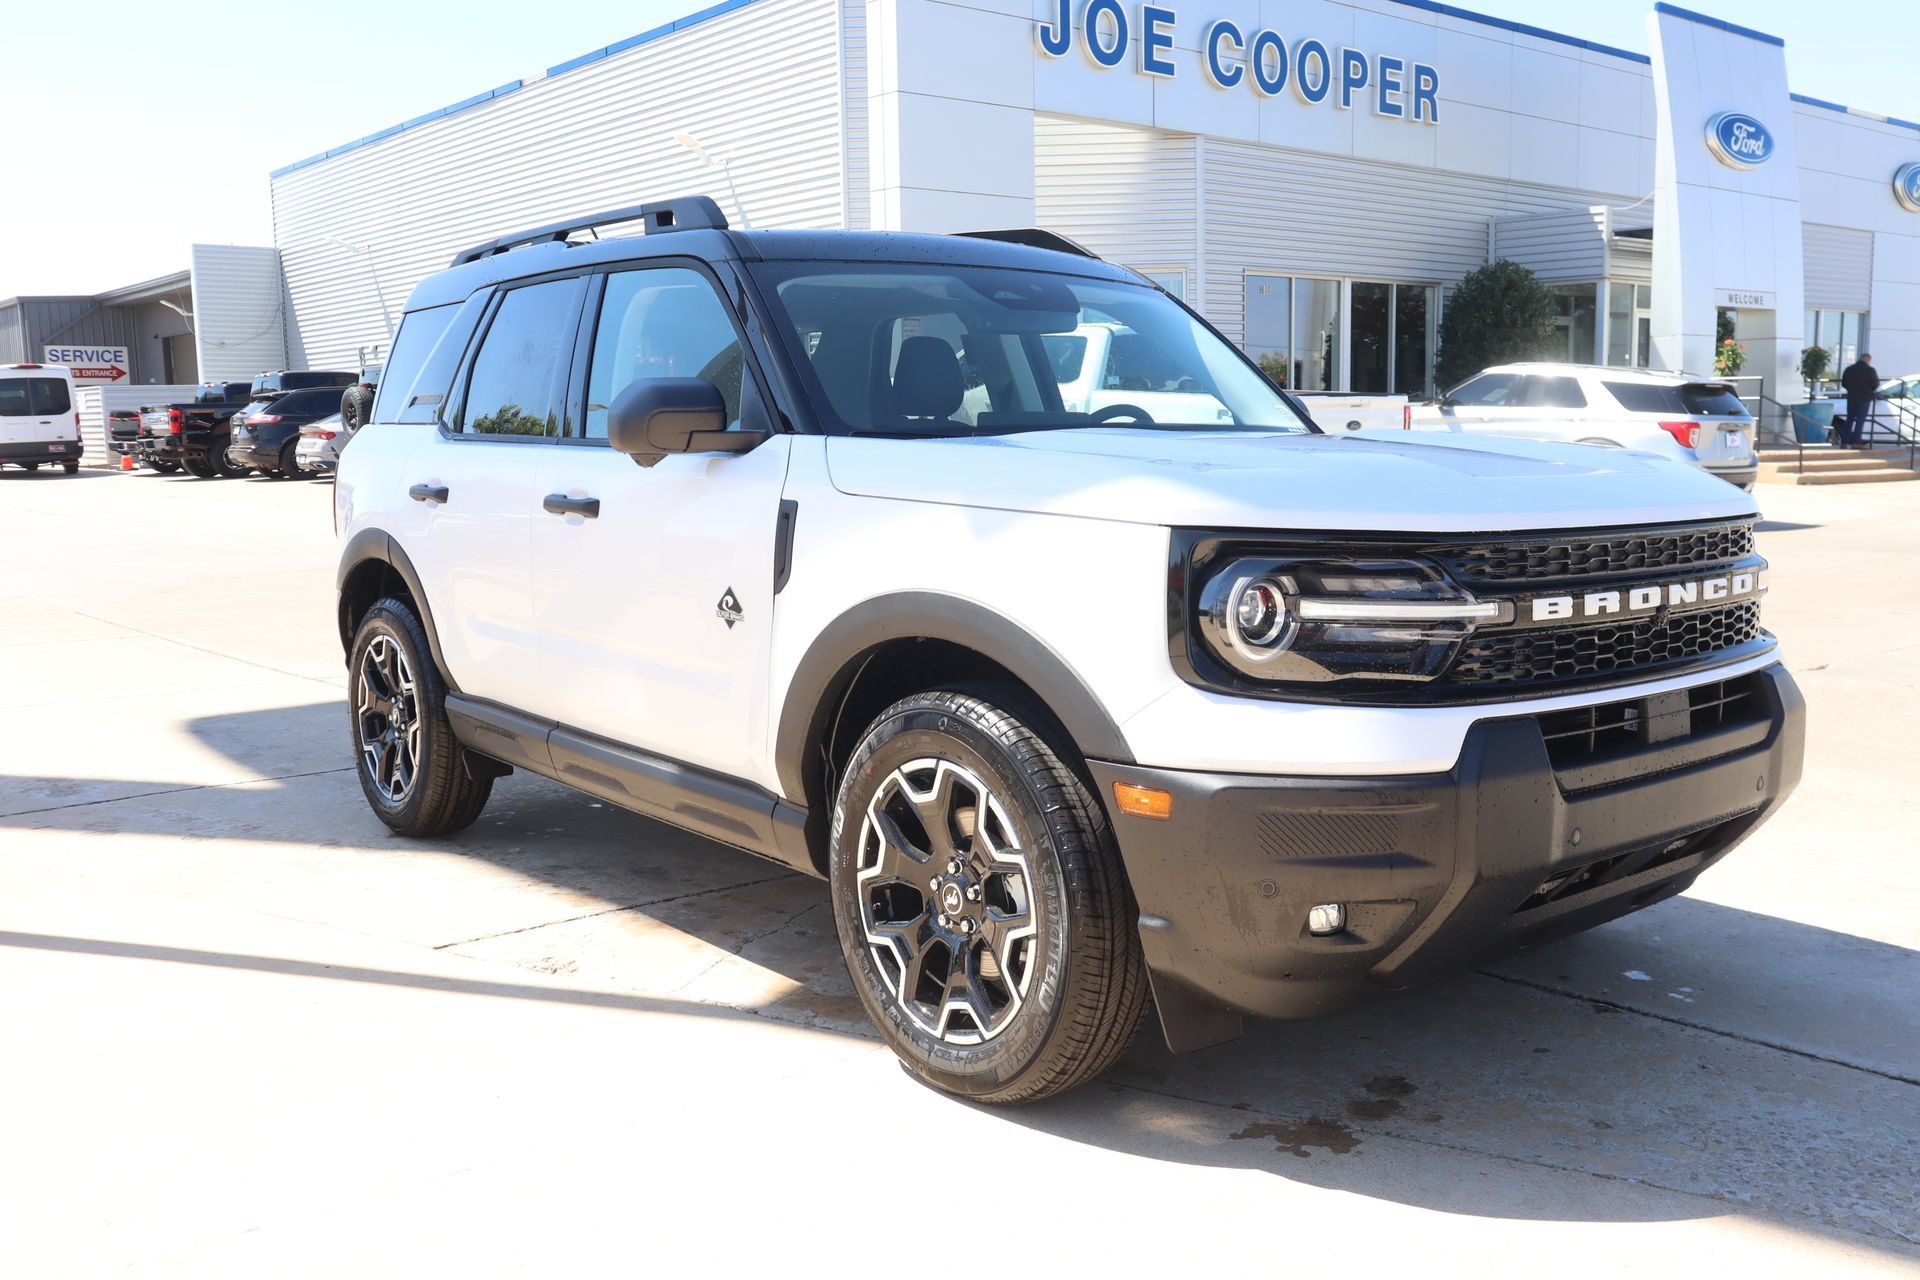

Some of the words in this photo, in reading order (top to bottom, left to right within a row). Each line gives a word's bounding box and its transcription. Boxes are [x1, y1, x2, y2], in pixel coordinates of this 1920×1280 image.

[1036, 0, 1176, 78] JOE
[1204, 19, 1440, 124] COOPER
[1730, 121, 1766, 157] Ford
[1727, 293, 1765, 306] WELCOME
[48, 348, 124, 363] SERVICE
[82, 369, 119, 377] ENTRANCE
[1532, 573, 1753, 622] BRONCO
